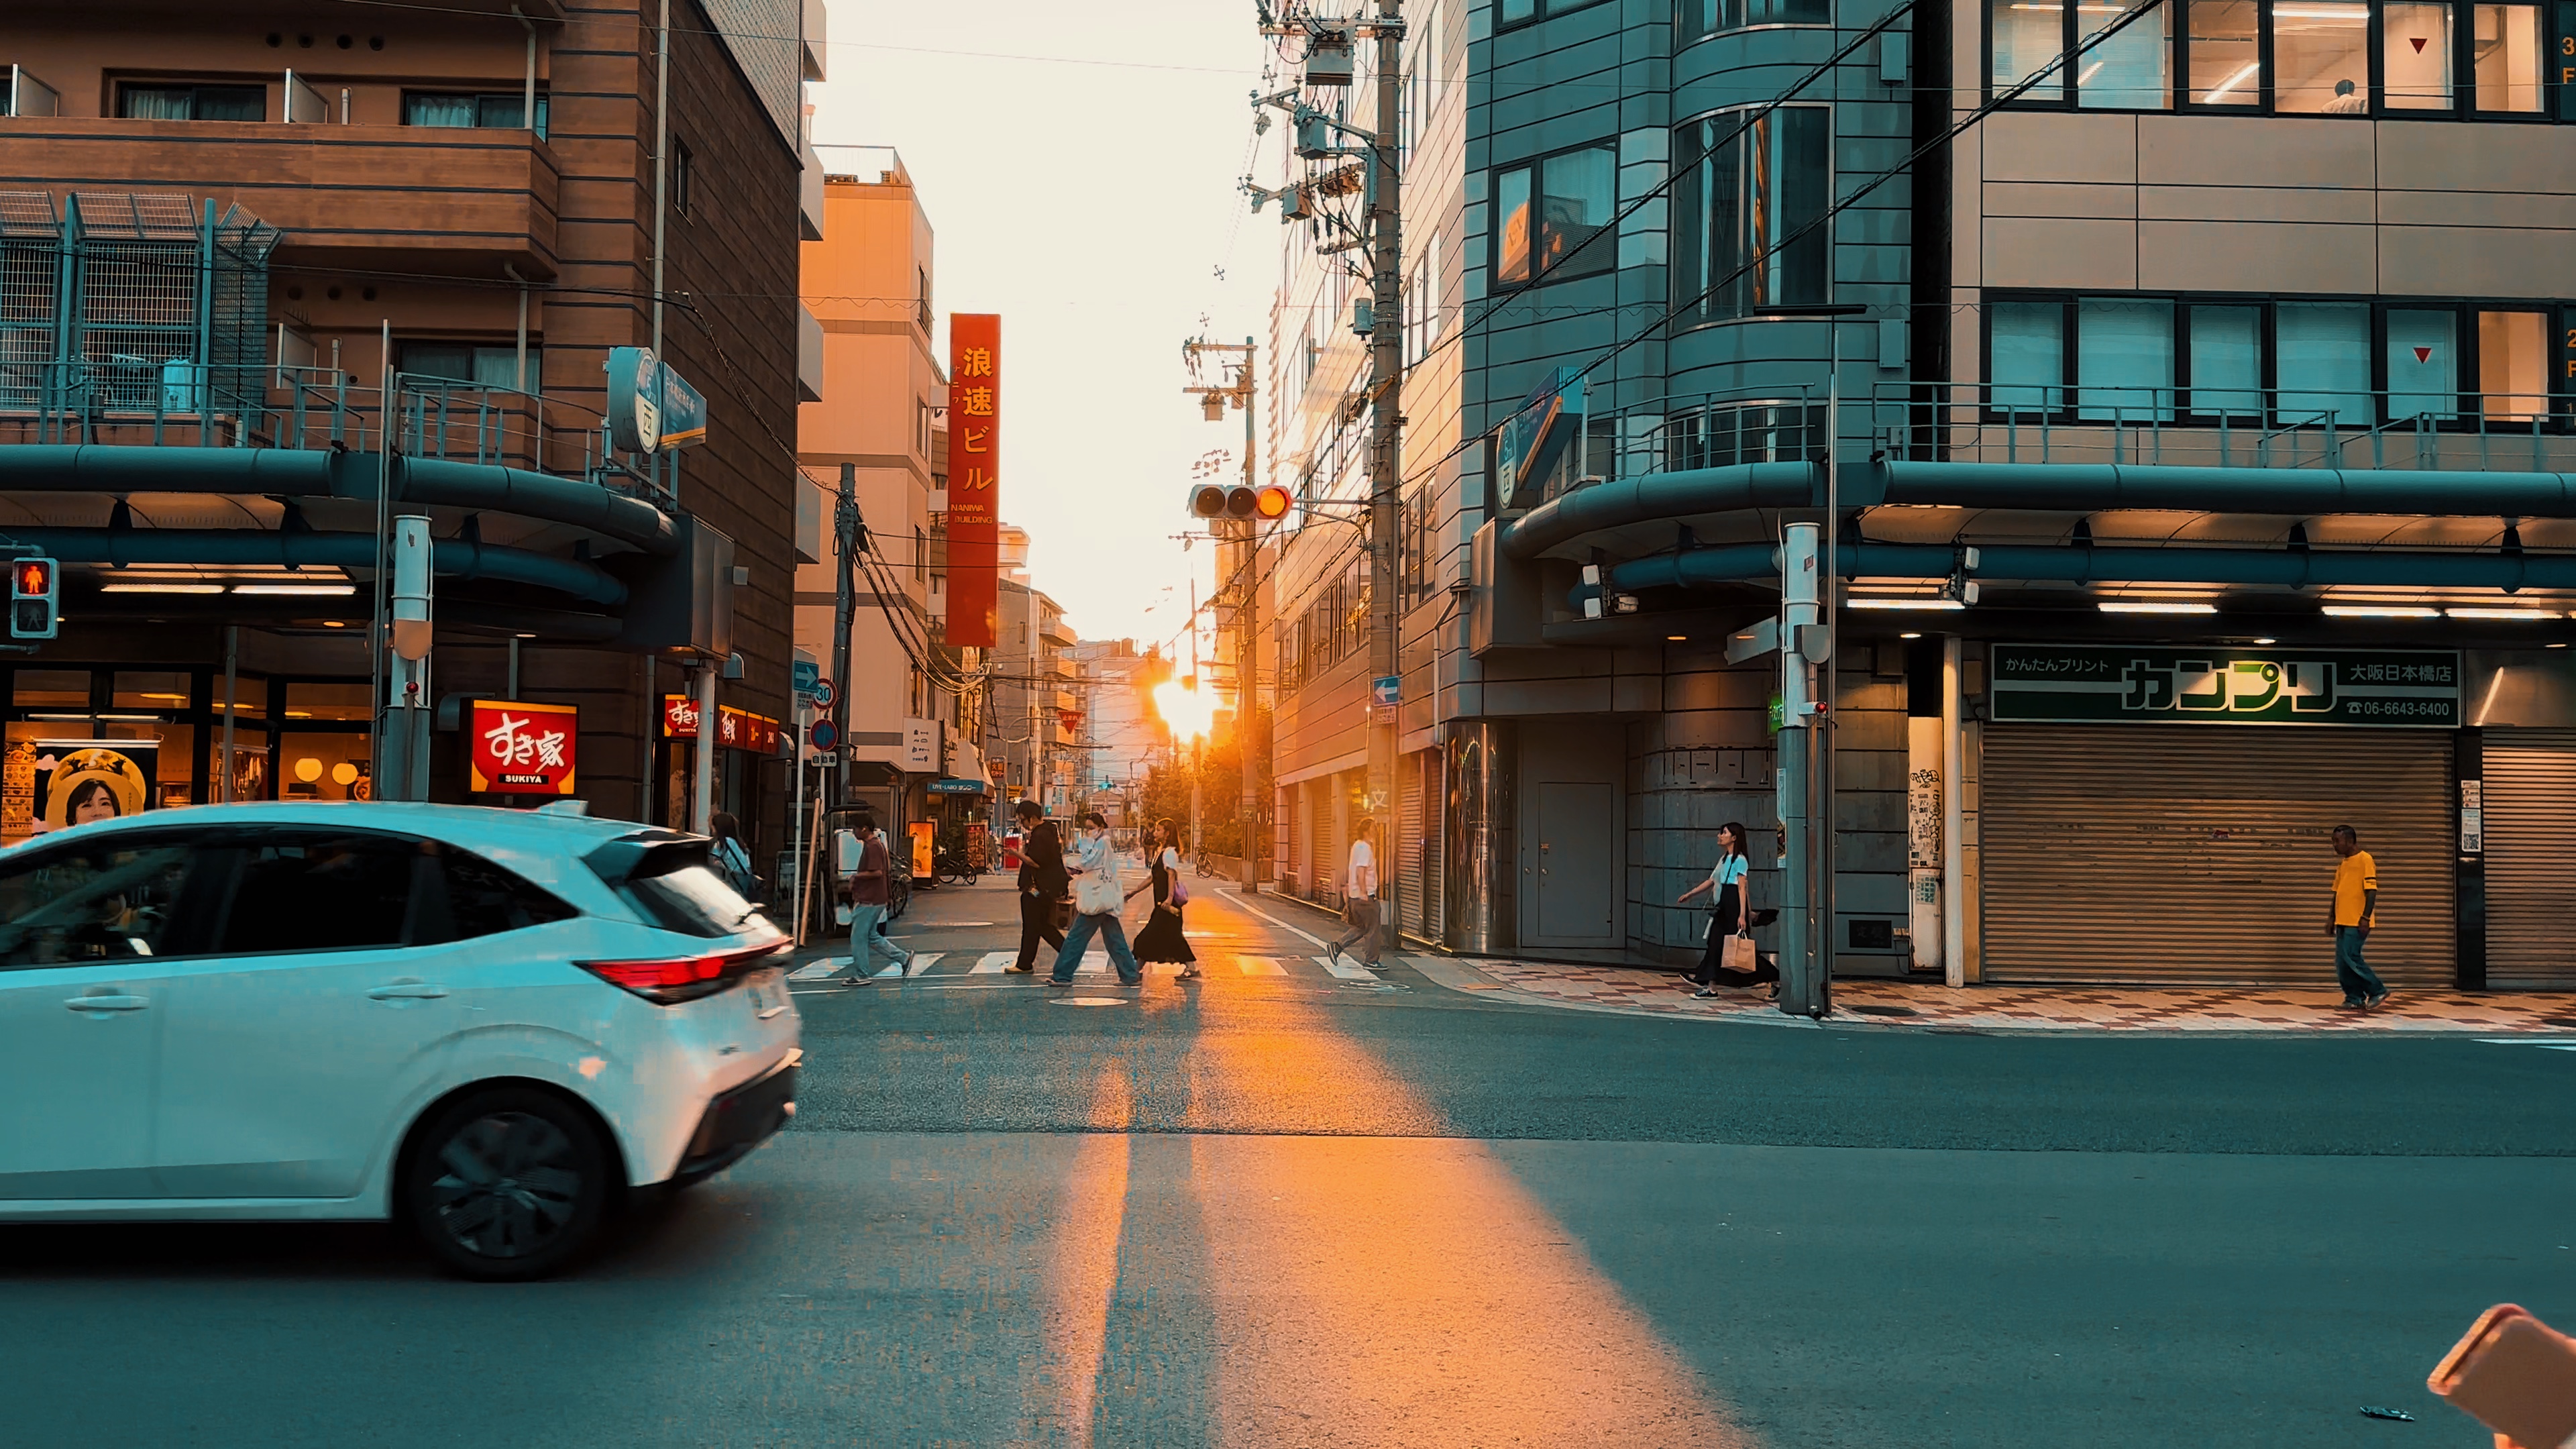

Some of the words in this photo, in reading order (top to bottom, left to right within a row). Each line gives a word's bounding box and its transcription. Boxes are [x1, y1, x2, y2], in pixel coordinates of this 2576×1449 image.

[643, 403, 653, 439] 西
[963, 347, 994, 491] 浪速ビル
[955, 515, 992, 524] BUILDING
[2006, 657, 2108, 672] かんたんプリント
[2350, 663, 2452, 682] 大阪日本橋店
[816, 687, 831, 701] 30
[2122, 659, 2337, 712] カンプリ
[2365, 702, 2449, 716] 06-6643-6400
[484, 712, 565, 773] すき家
[505, 775, 542, 784] SUKIYA
